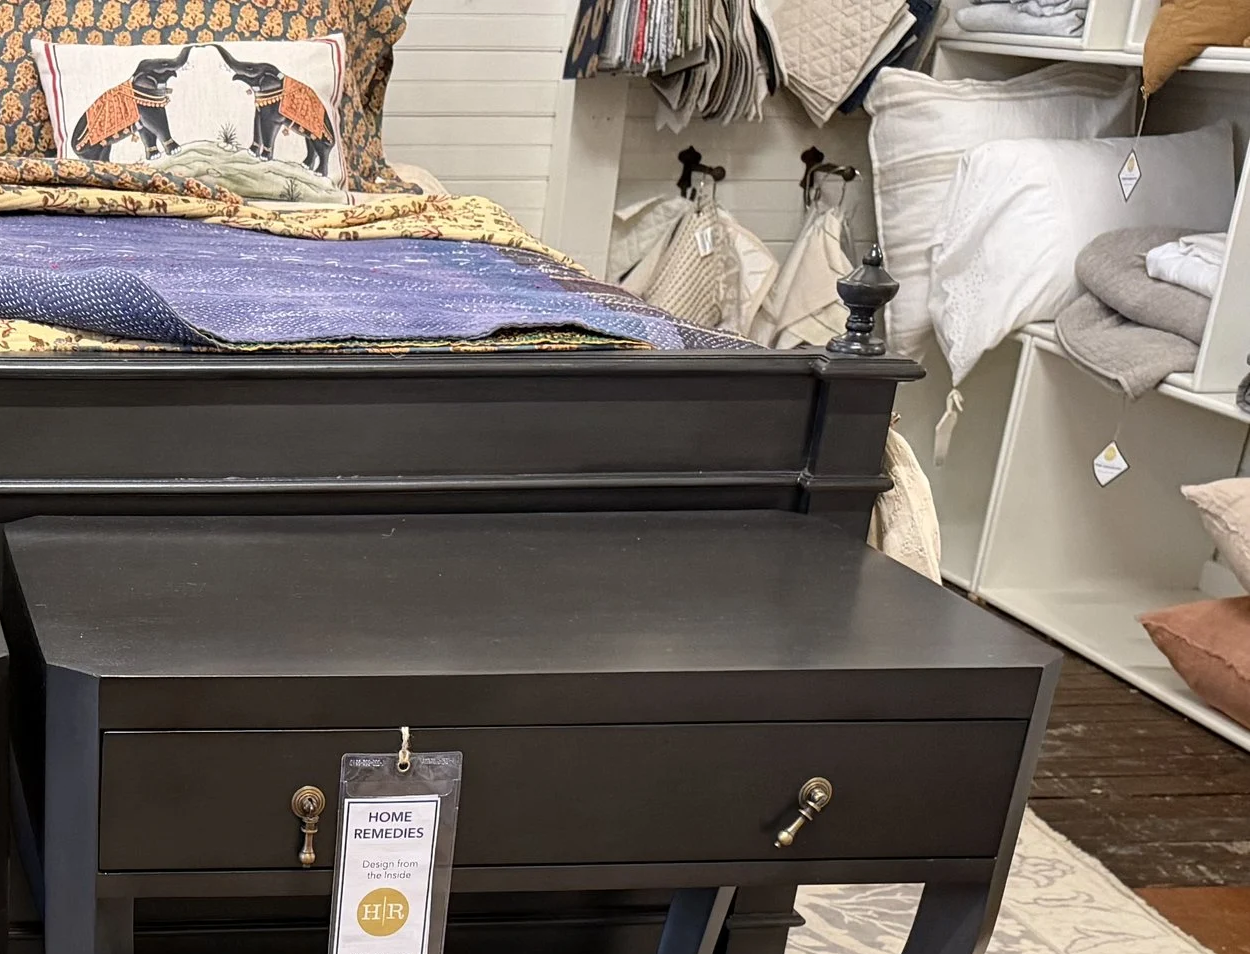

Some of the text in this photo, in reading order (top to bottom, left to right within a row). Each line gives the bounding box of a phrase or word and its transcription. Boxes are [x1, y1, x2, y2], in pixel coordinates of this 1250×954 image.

[368, 811, 413, 823] HOME
[353, 827, 424, 839] REMEDIES
[362, 860, 419, 870] Design from
[367, 871, 412, 880] the Inside
